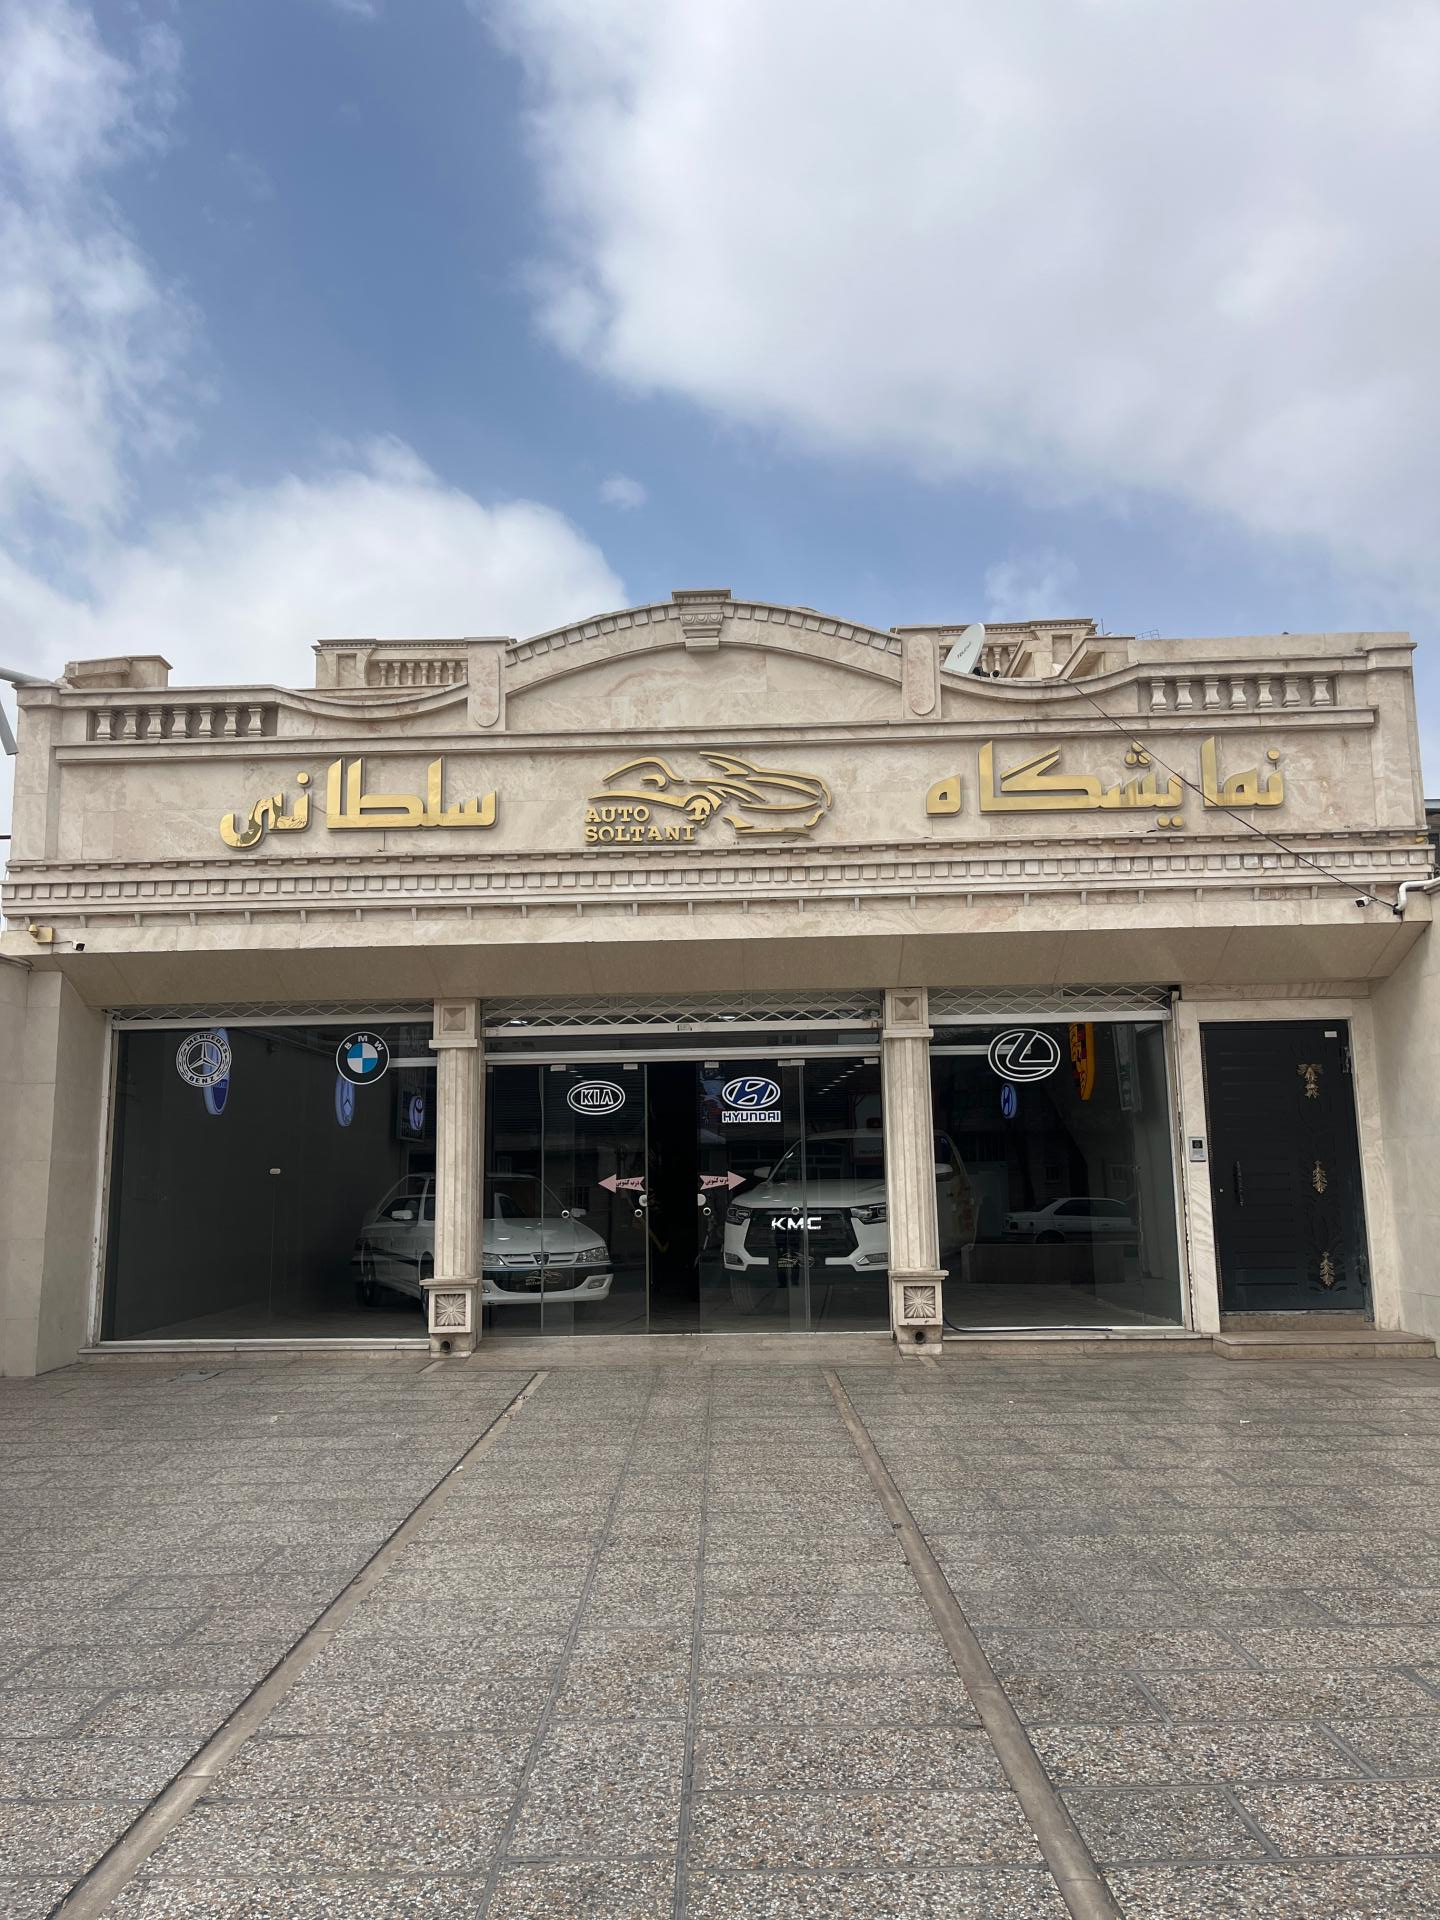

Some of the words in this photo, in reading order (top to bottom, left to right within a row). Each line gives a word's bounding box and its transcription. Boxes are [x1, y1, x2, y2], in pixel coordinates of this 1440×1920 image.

[926, 736, 1285, 830] نمایشگاه
[219, 757, 497, 848] سلطانی
[584, 805, 650, 823] AUTO
[584, 825, 696, 843] SOLTANI
[186, 1034, 228, 1054] MERCEDES
[344, 1035, 385, 1051] BMW
[189, 1076, 215, 1084] BENZ
[580, 1089, 614, 1105] KIA
[722, 1110, 781, 1123] HYUNDAI
[771, 1216, 822, 1230] KMC
